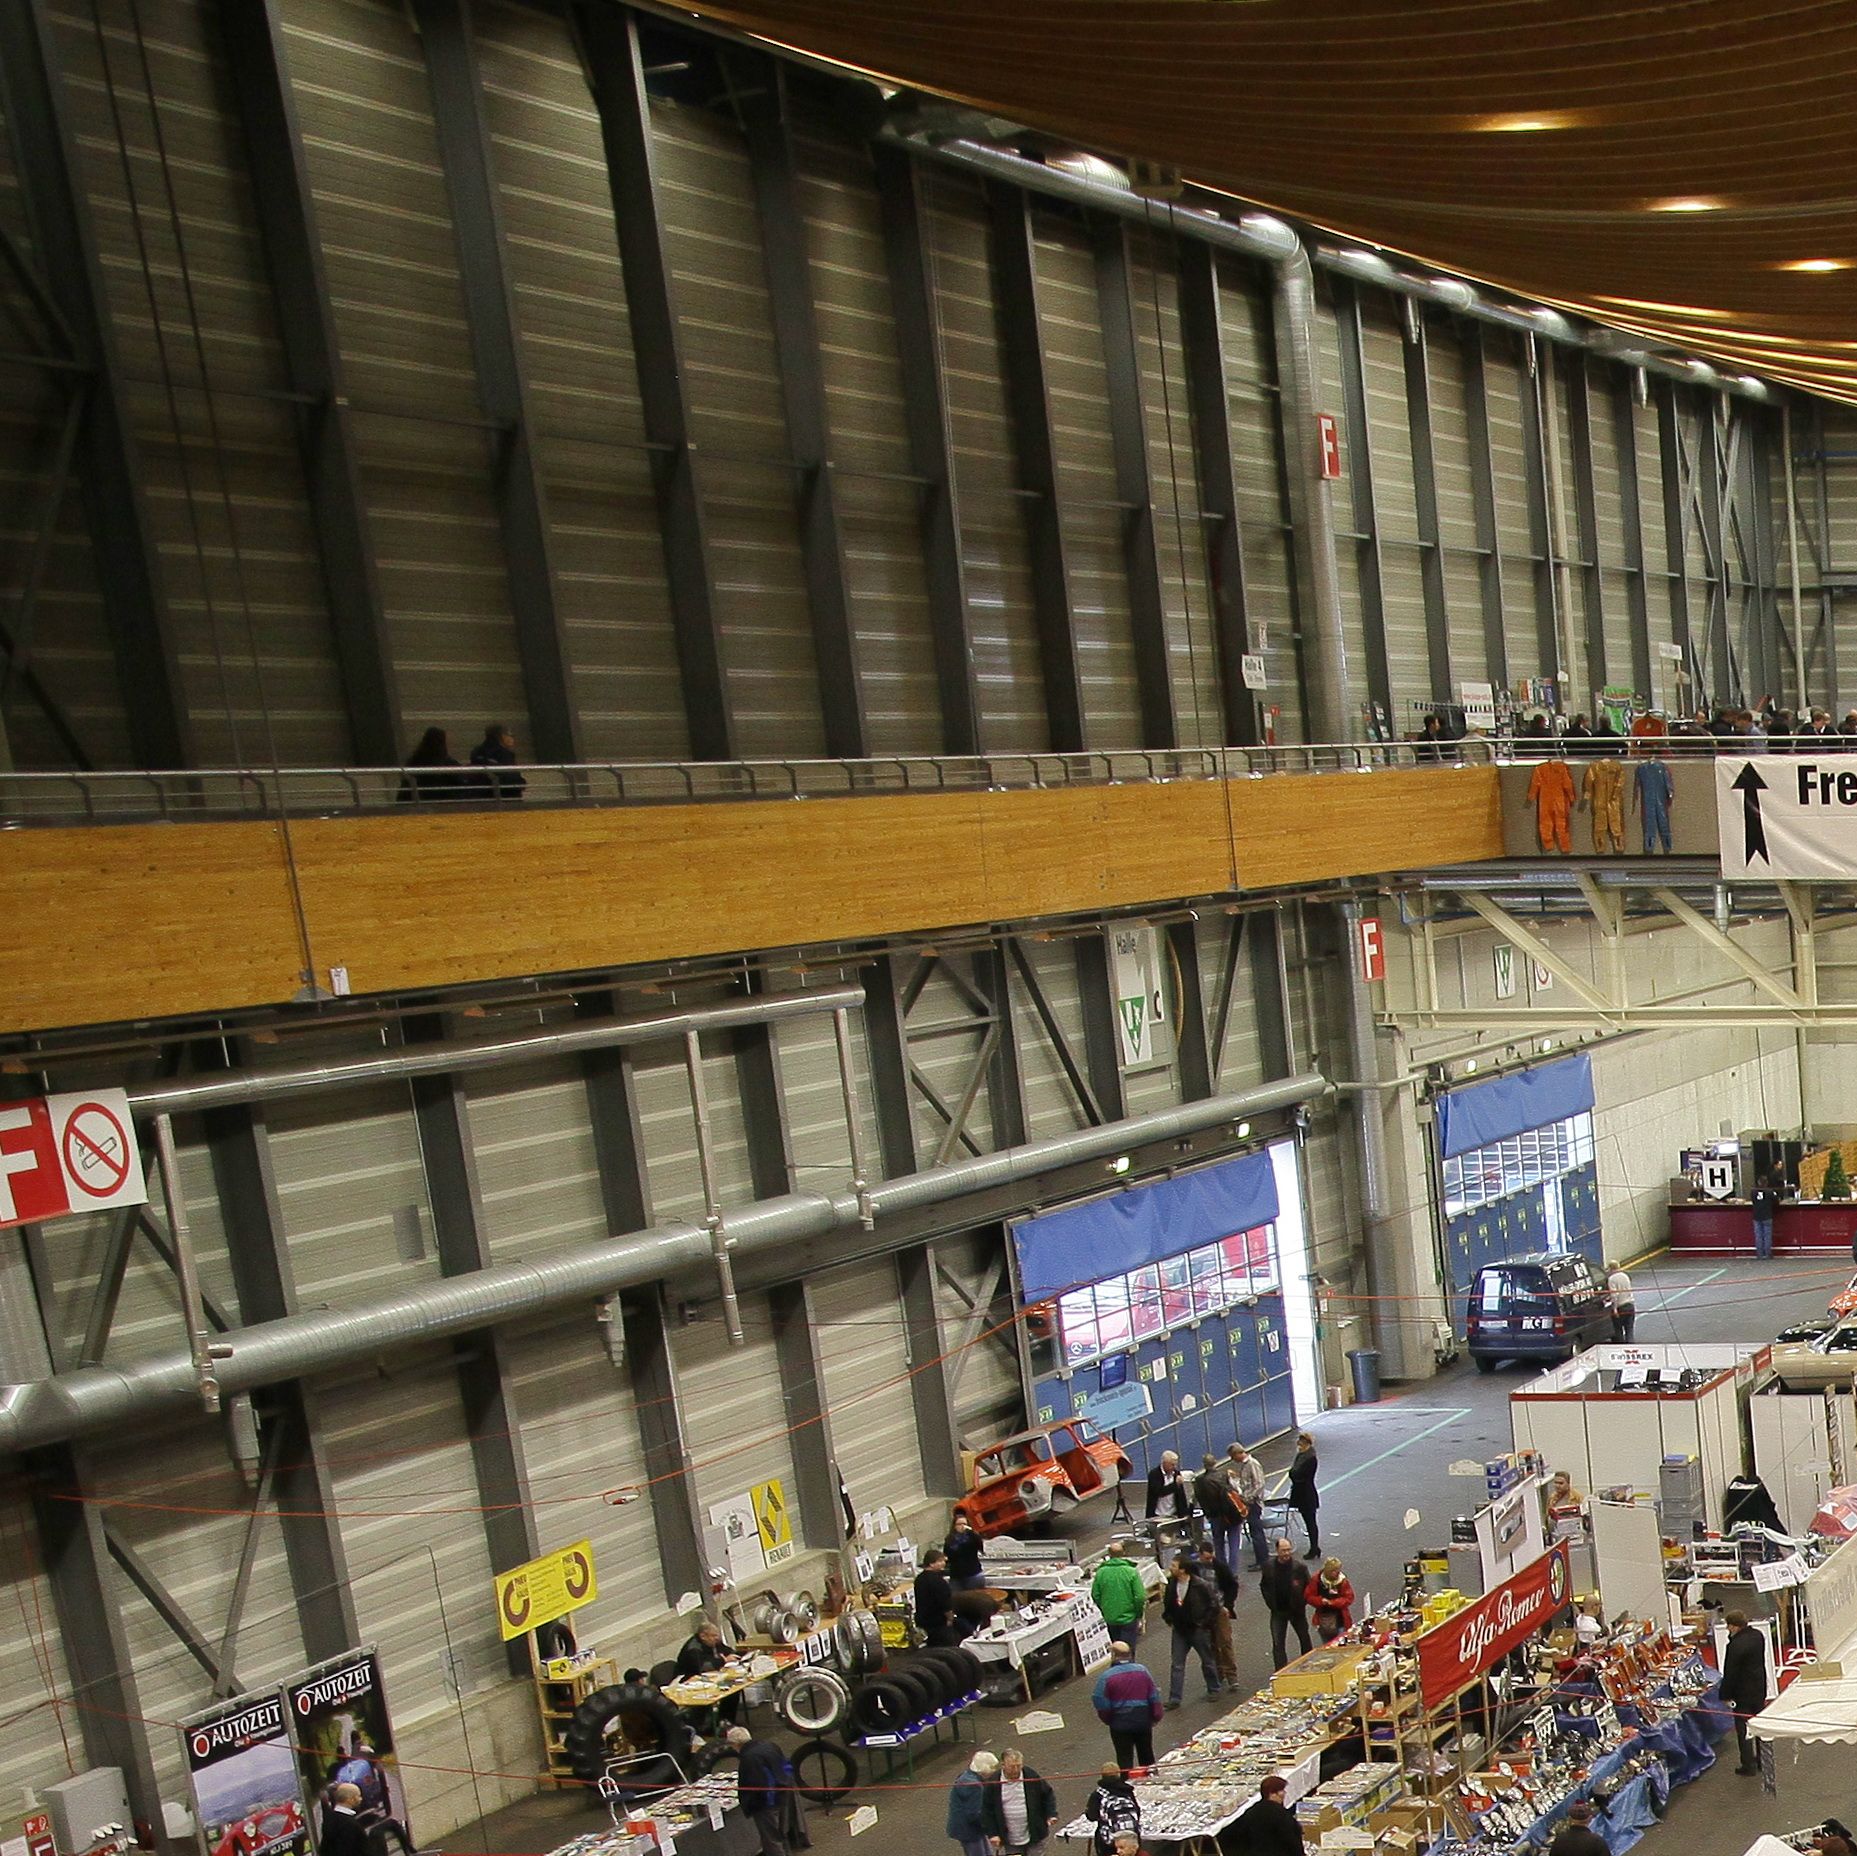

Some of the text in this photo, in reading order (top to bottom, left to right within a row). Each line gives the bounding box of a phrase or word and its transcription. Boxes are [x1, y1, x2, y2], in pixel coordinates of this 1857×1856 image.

[1319, 417, 1333, 476] F
[1362, 922, 1378, 978] F
[0, 1106, 39, 1221] F
[1710, 1168, 1726, 1187] H
[1458, 1585, 1546, 1674] Alfa Romeo
[314, 1666, 371, 1706] AUTOZEIT
[212, 1705, 281, 1747] AUTOZEIT
